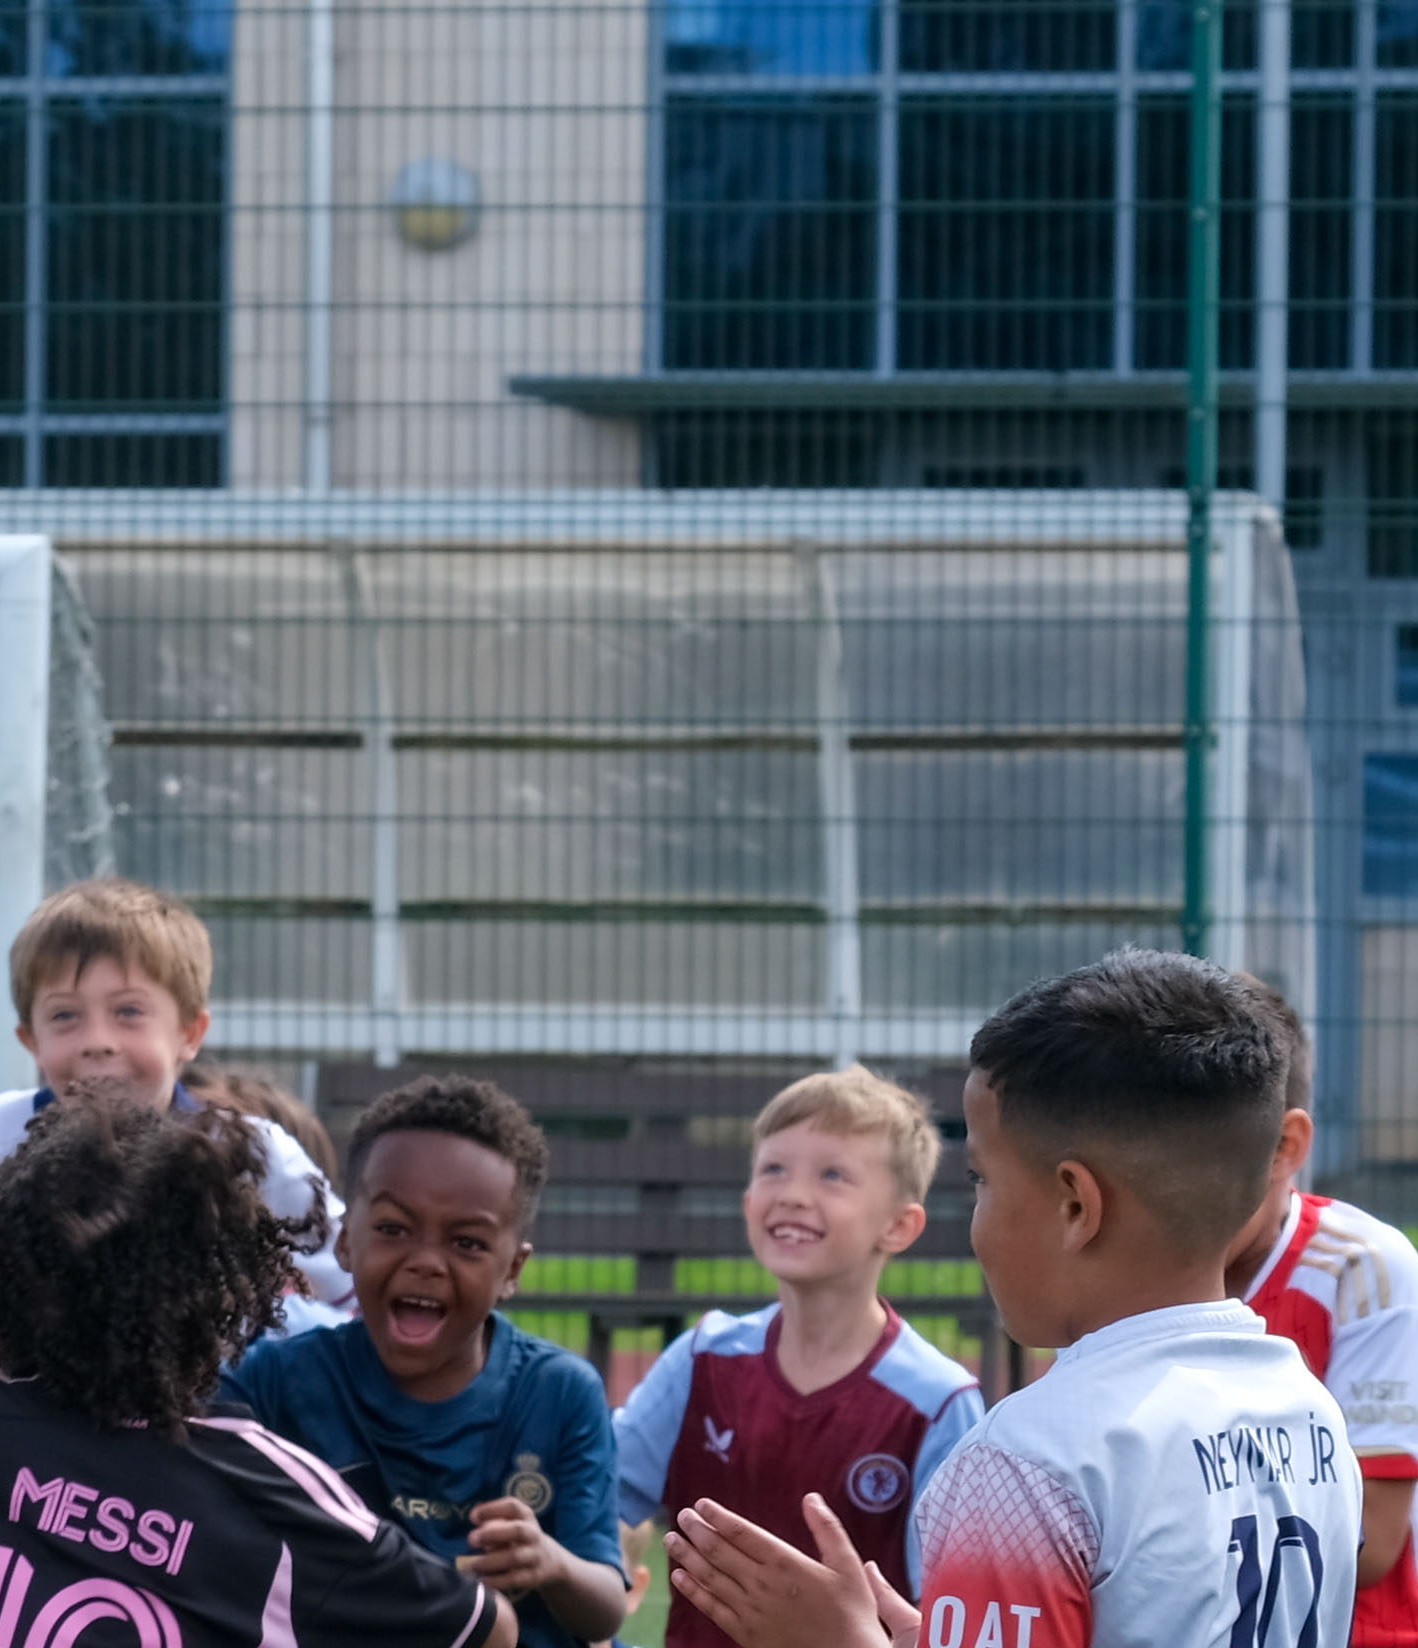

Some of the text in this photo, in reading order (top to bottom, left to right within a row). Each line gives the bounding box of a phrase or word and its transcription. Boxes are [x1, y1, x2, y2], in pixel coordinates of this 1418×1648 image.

[1348, 1380, 1409, 1401] VISIT
[1192, 1426, 1296, 1495] NEYMAR
[8, 1466, 194, 1576] MESSI
